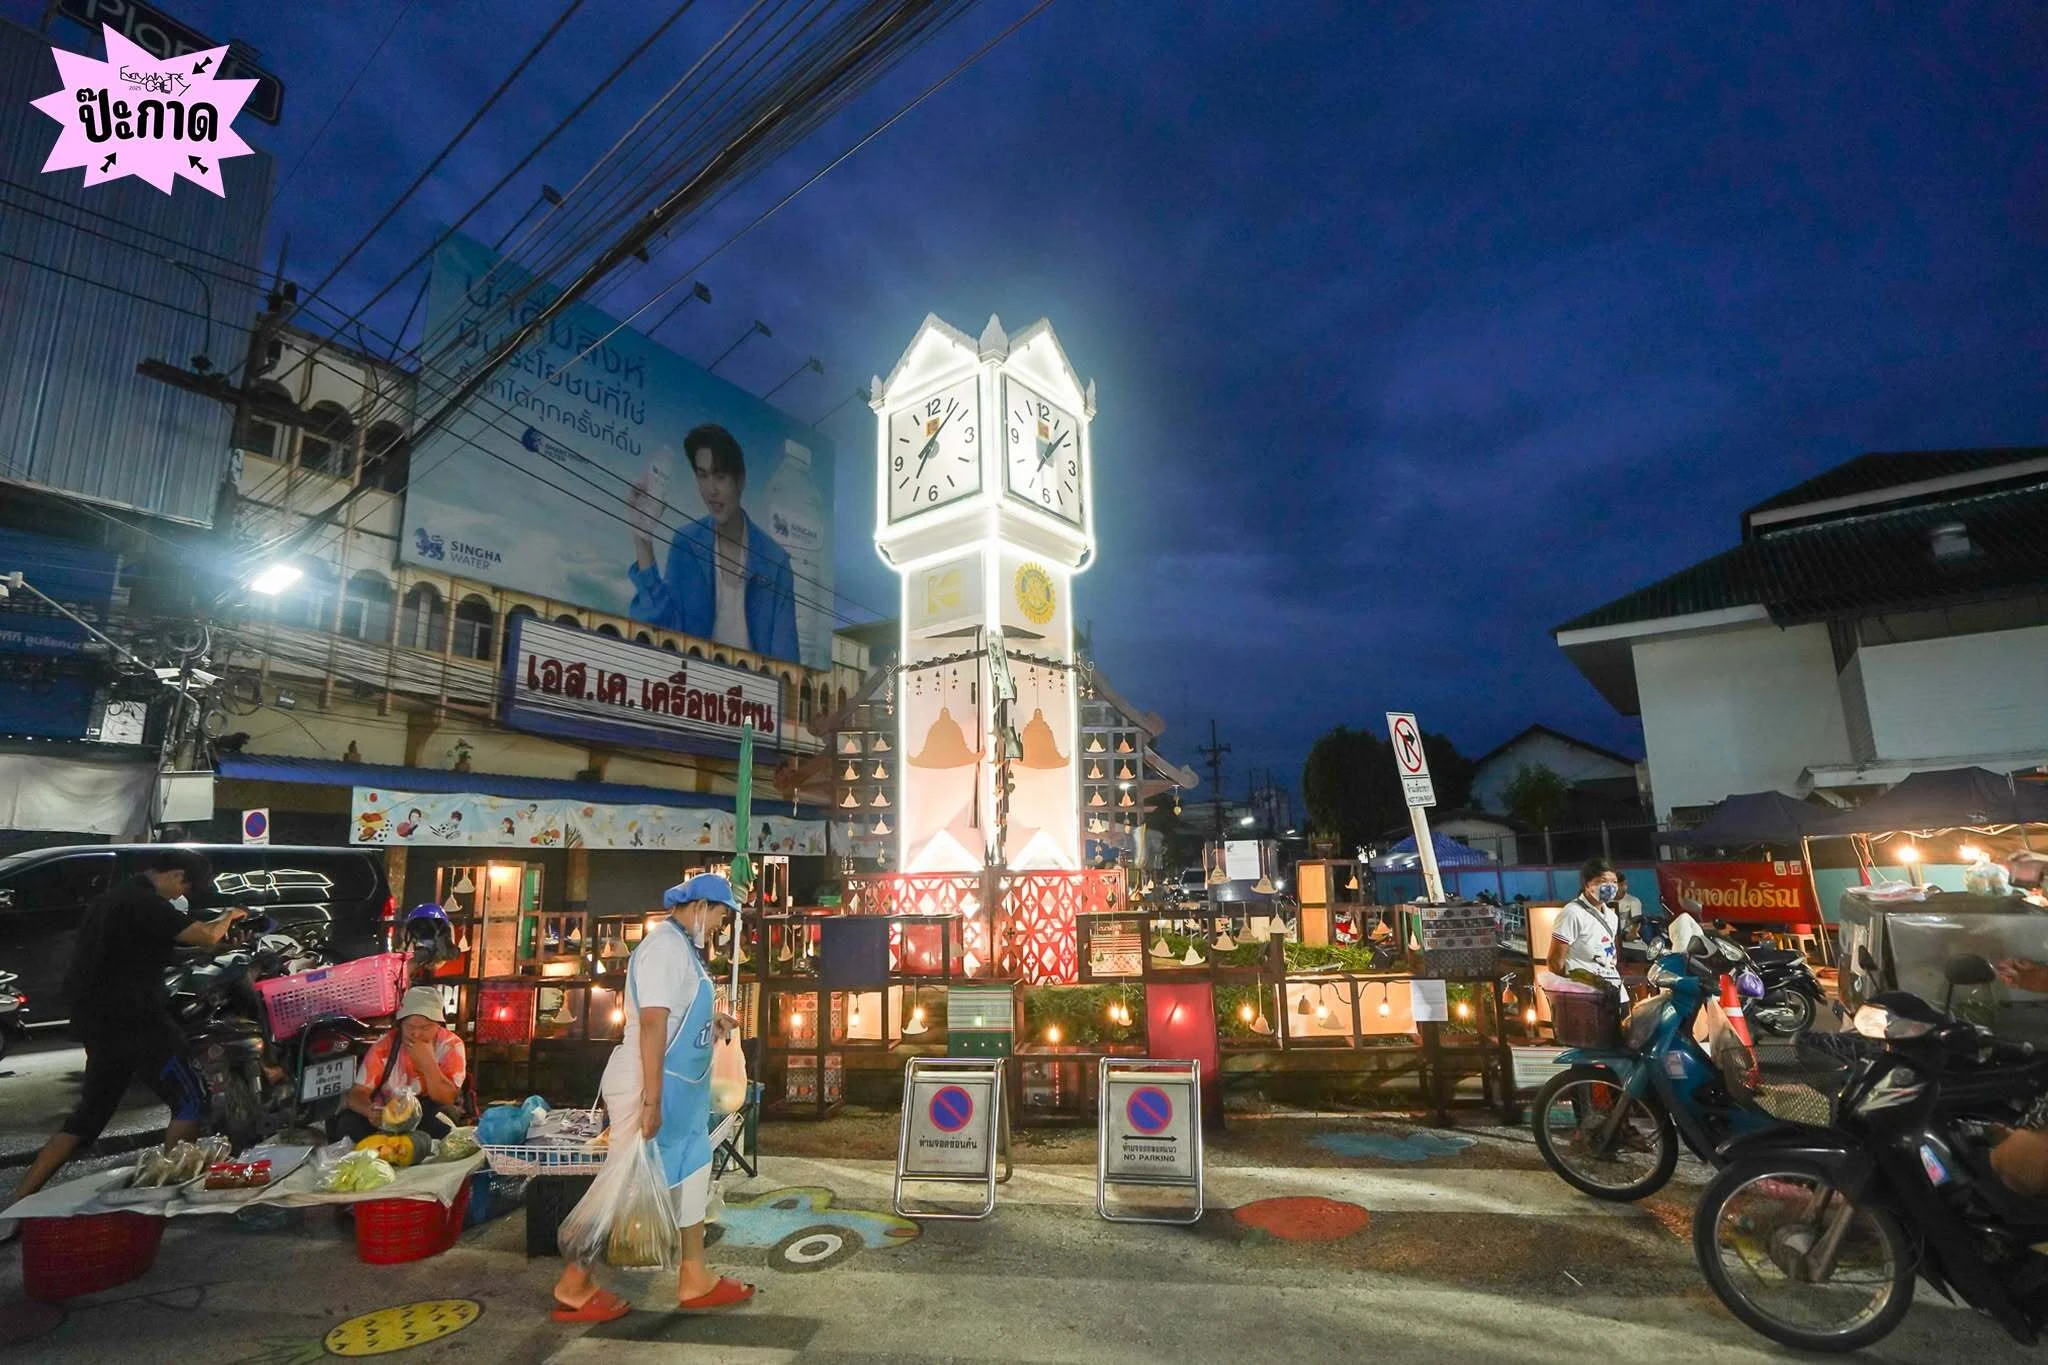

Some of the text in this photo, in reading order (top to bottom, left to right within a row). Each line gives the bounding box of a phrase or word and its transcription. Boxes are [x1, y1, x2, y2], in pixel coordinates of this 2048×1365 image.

[925, 398, 941, 418] 12
[1036, 402, 1051, 423] 12
[964, 426, 975, 444] 3
[1010, 427, 1020, 445] 9
[894, 455, 904, 472] 9
[1067, 460, 1077, 477] 3
[928, 484, 939, 502] 6
[1042, 487, 1052, 504] 6
[450, 540, 503, 564] SINGHA
[450, 551, 491, 570] WATER
[1123, 1153, 1176, 1162] NO PARKING
